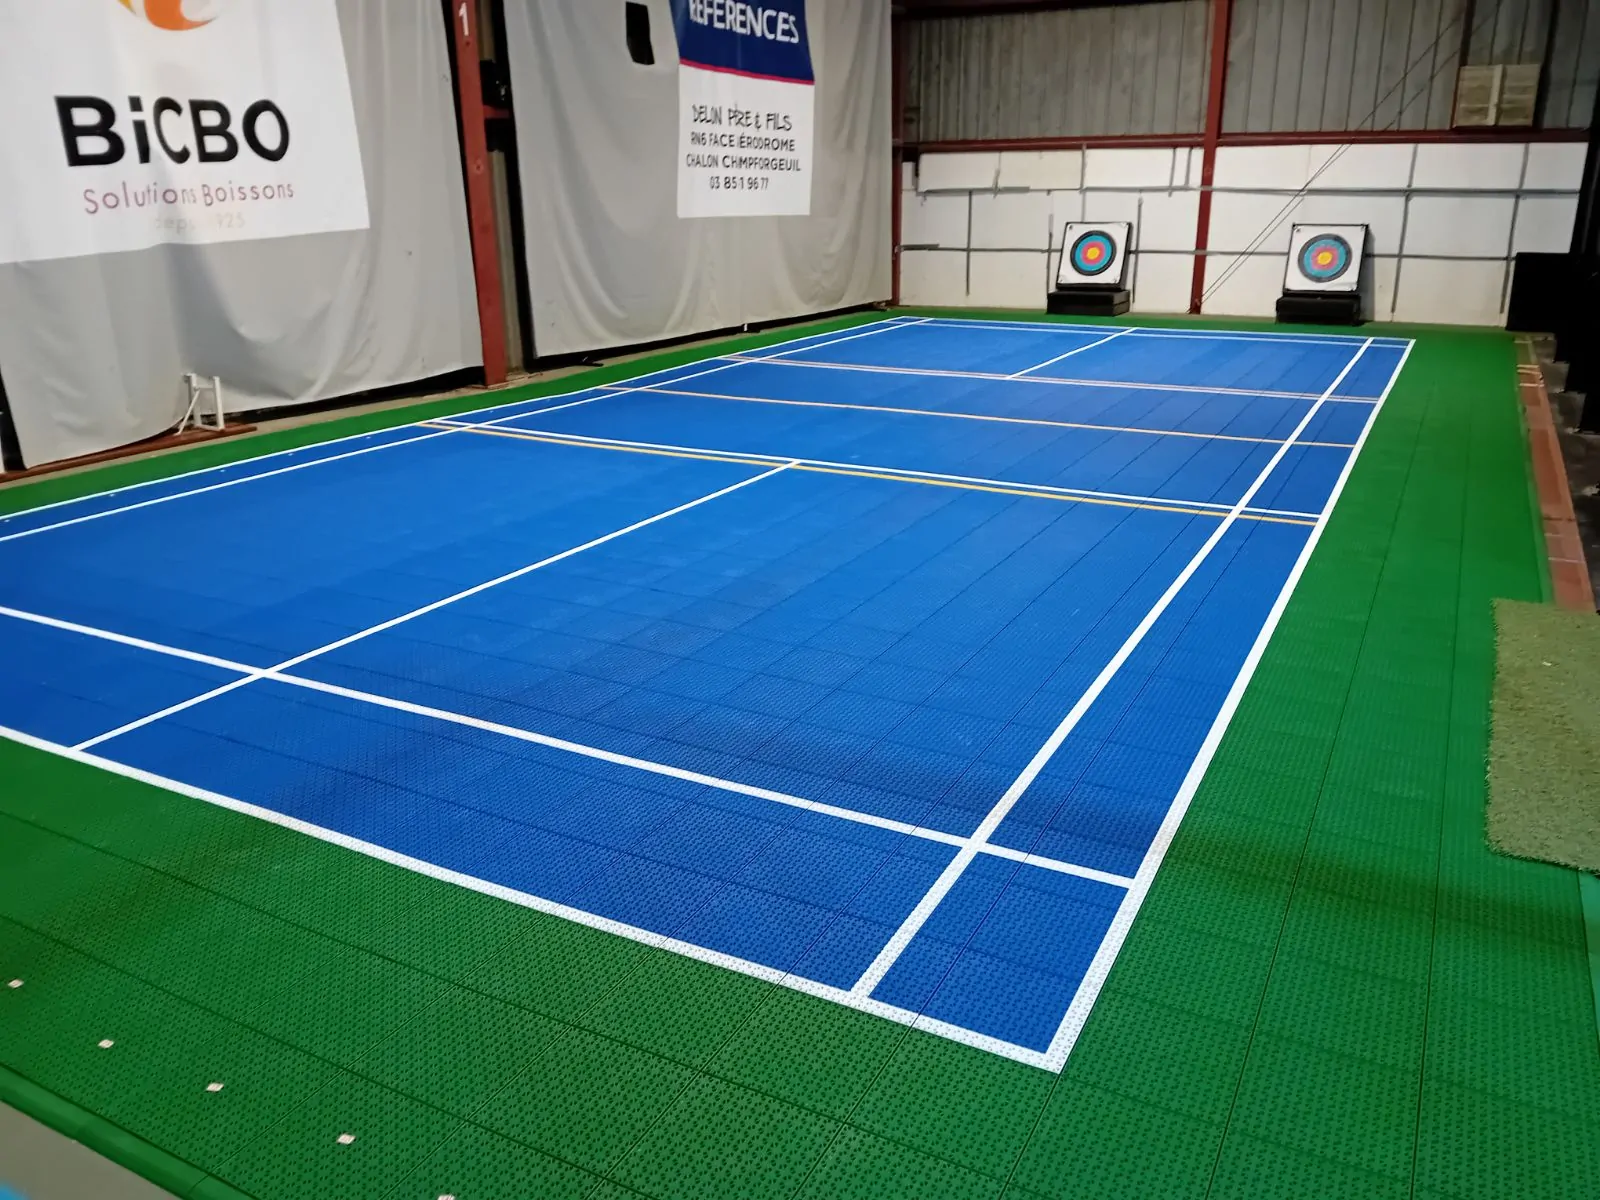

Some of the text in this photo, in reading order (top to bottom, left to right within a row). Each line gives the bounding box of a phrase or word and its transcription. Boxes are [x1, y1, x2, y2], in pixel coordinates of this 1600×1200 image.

[459, 2, 470, 36] 1
[54, 95, 290, 167] BiCBO
[766, 113, 793, 131] FILS
[709, 133, 735, 148] FACE
[723, 176, 738, 190] 85
[747, 177, 759, 190] 96
[83, 179, 294, 215] Solutions Boissons
